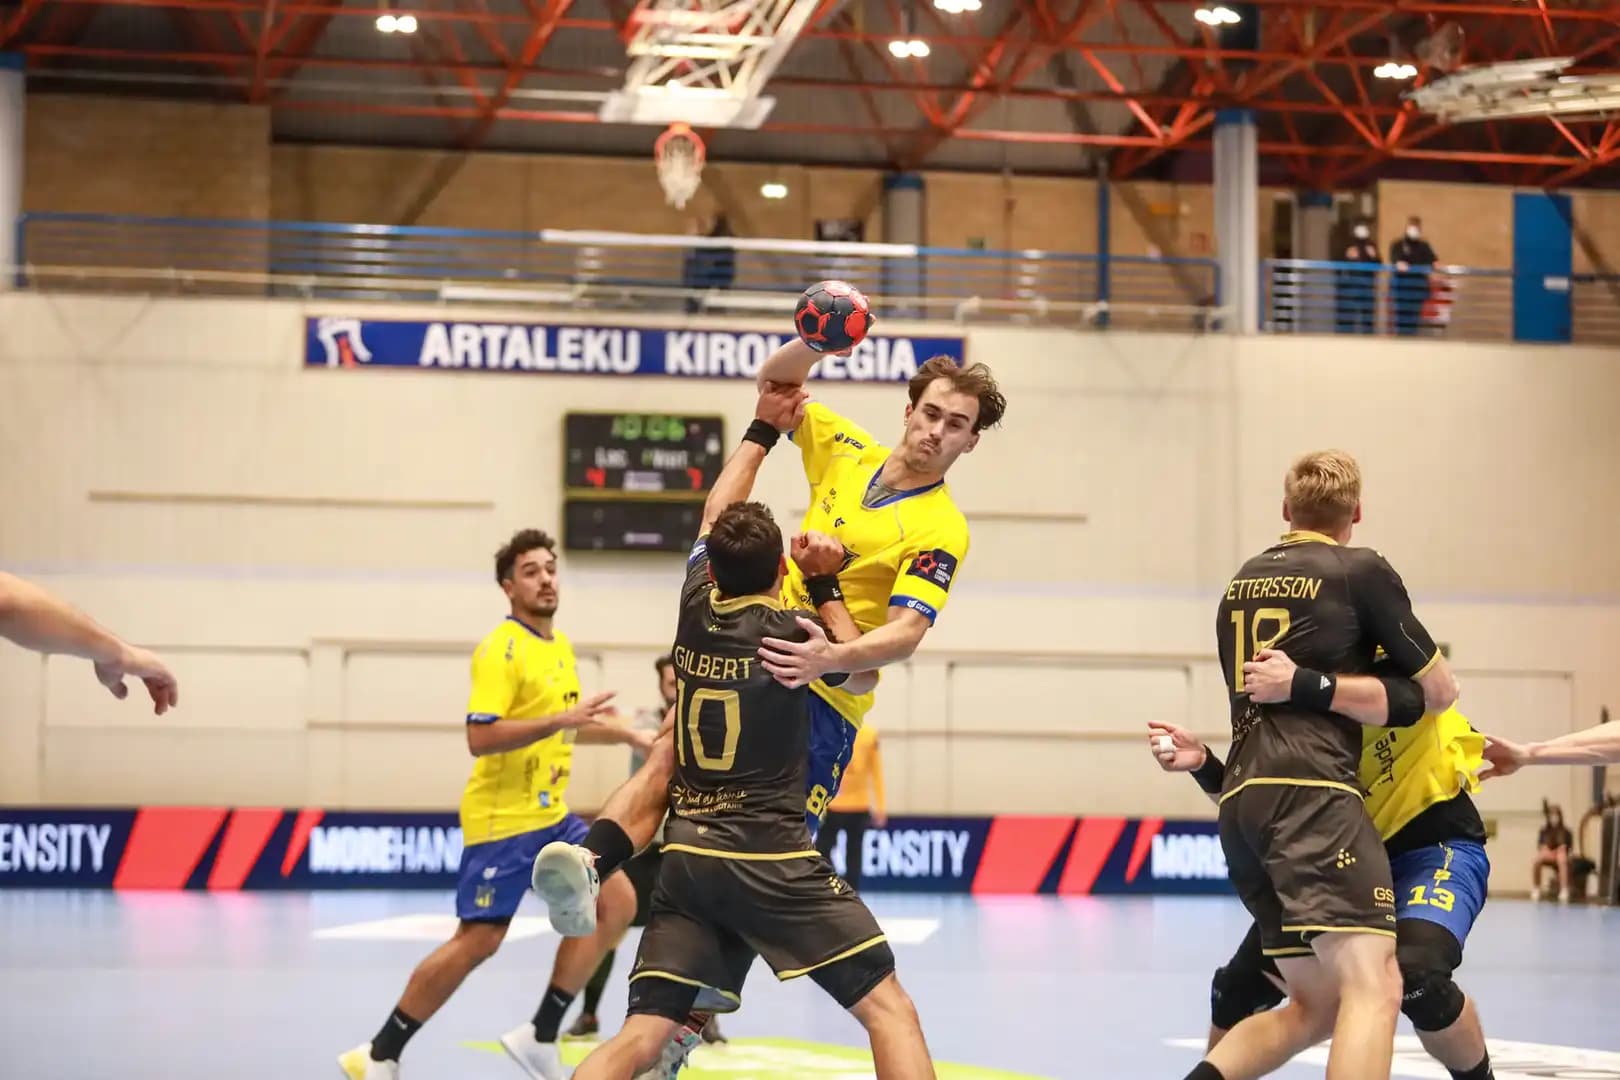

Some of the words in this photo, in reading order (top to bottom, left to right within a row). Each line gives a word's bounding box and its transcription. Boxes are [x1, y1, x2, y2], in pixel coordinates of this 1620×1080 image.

[419, 322, 641, 373] ARTALEKU
[664, 331, 919, 381] KIROEGIA
[1224, 576, 1322, 600] ETTERSSON
[674, 645, 755, 680] GILBERT
[677, 677, 742, 771] 10
[0, 823, 112, 873] ENSITY
[831, 828, 970, 879] ENSITY
[1407, 885, 1456, 913] 13
